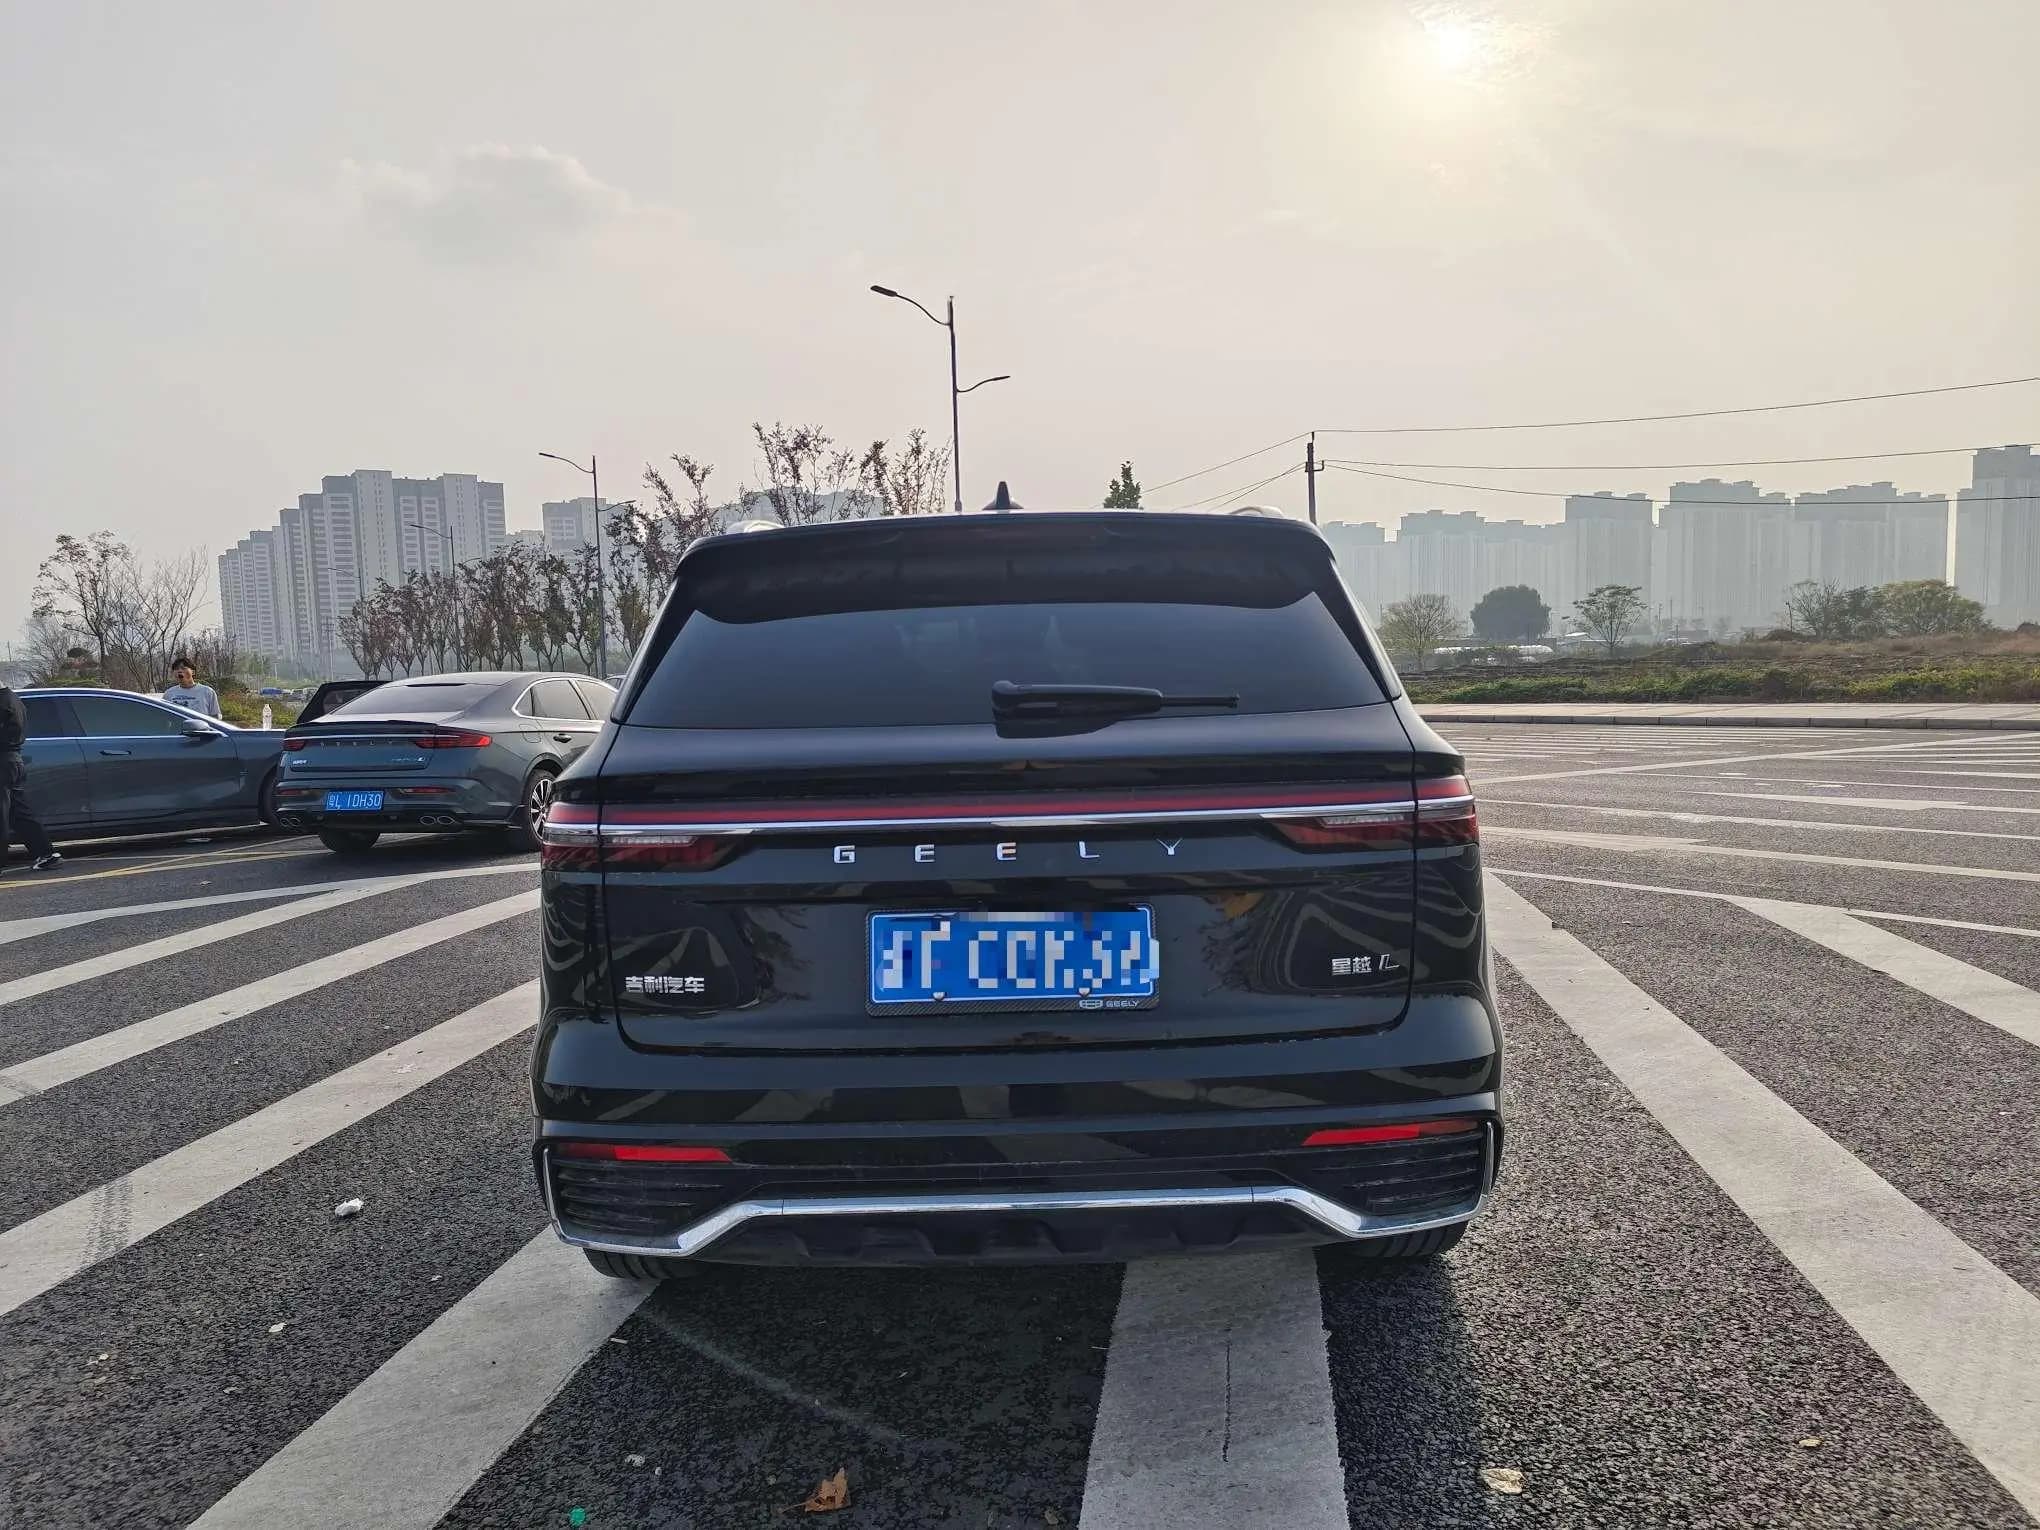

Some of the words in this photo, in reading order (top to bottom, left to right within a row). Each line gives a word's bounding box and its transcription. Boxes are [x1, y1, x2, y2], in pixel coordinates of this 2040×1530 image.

[833, 839, 1182, 864] GEELY
[1331, 956, 1372, 976] 星越
[625, 976, 705, 994] 吉利汽车
[1106, 1000, 1138, 1008] GEELY
